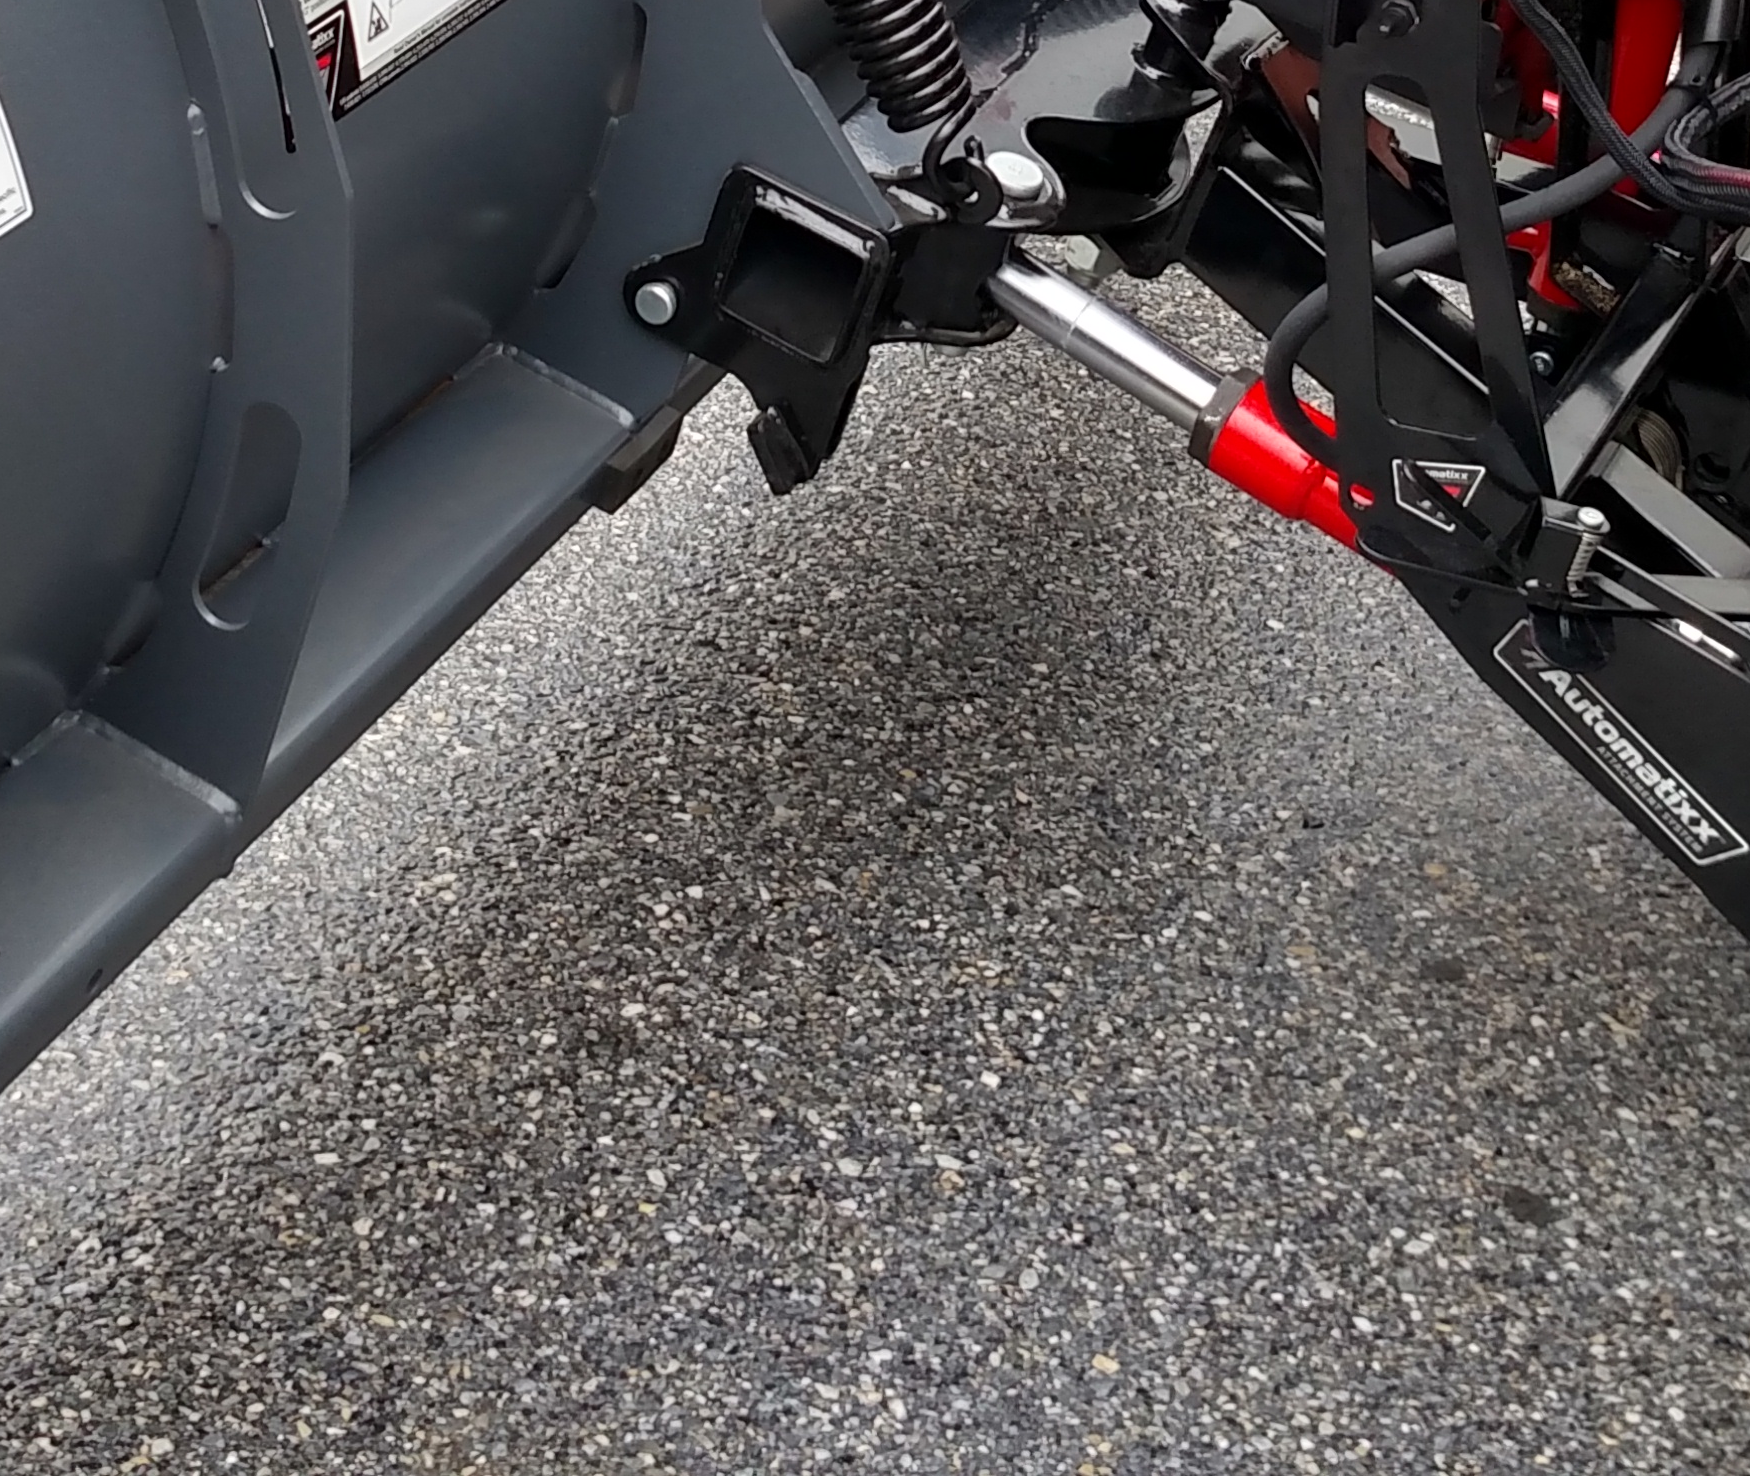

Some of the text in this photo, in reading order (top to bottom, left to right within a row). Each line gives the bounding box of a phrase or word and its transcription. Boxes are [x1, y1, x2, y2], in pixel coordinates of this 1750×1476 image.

[1538, 670, 1721, 845] Automatixx
[1596, 745, 1703, 853] ATTACHMENT SYSTEM
